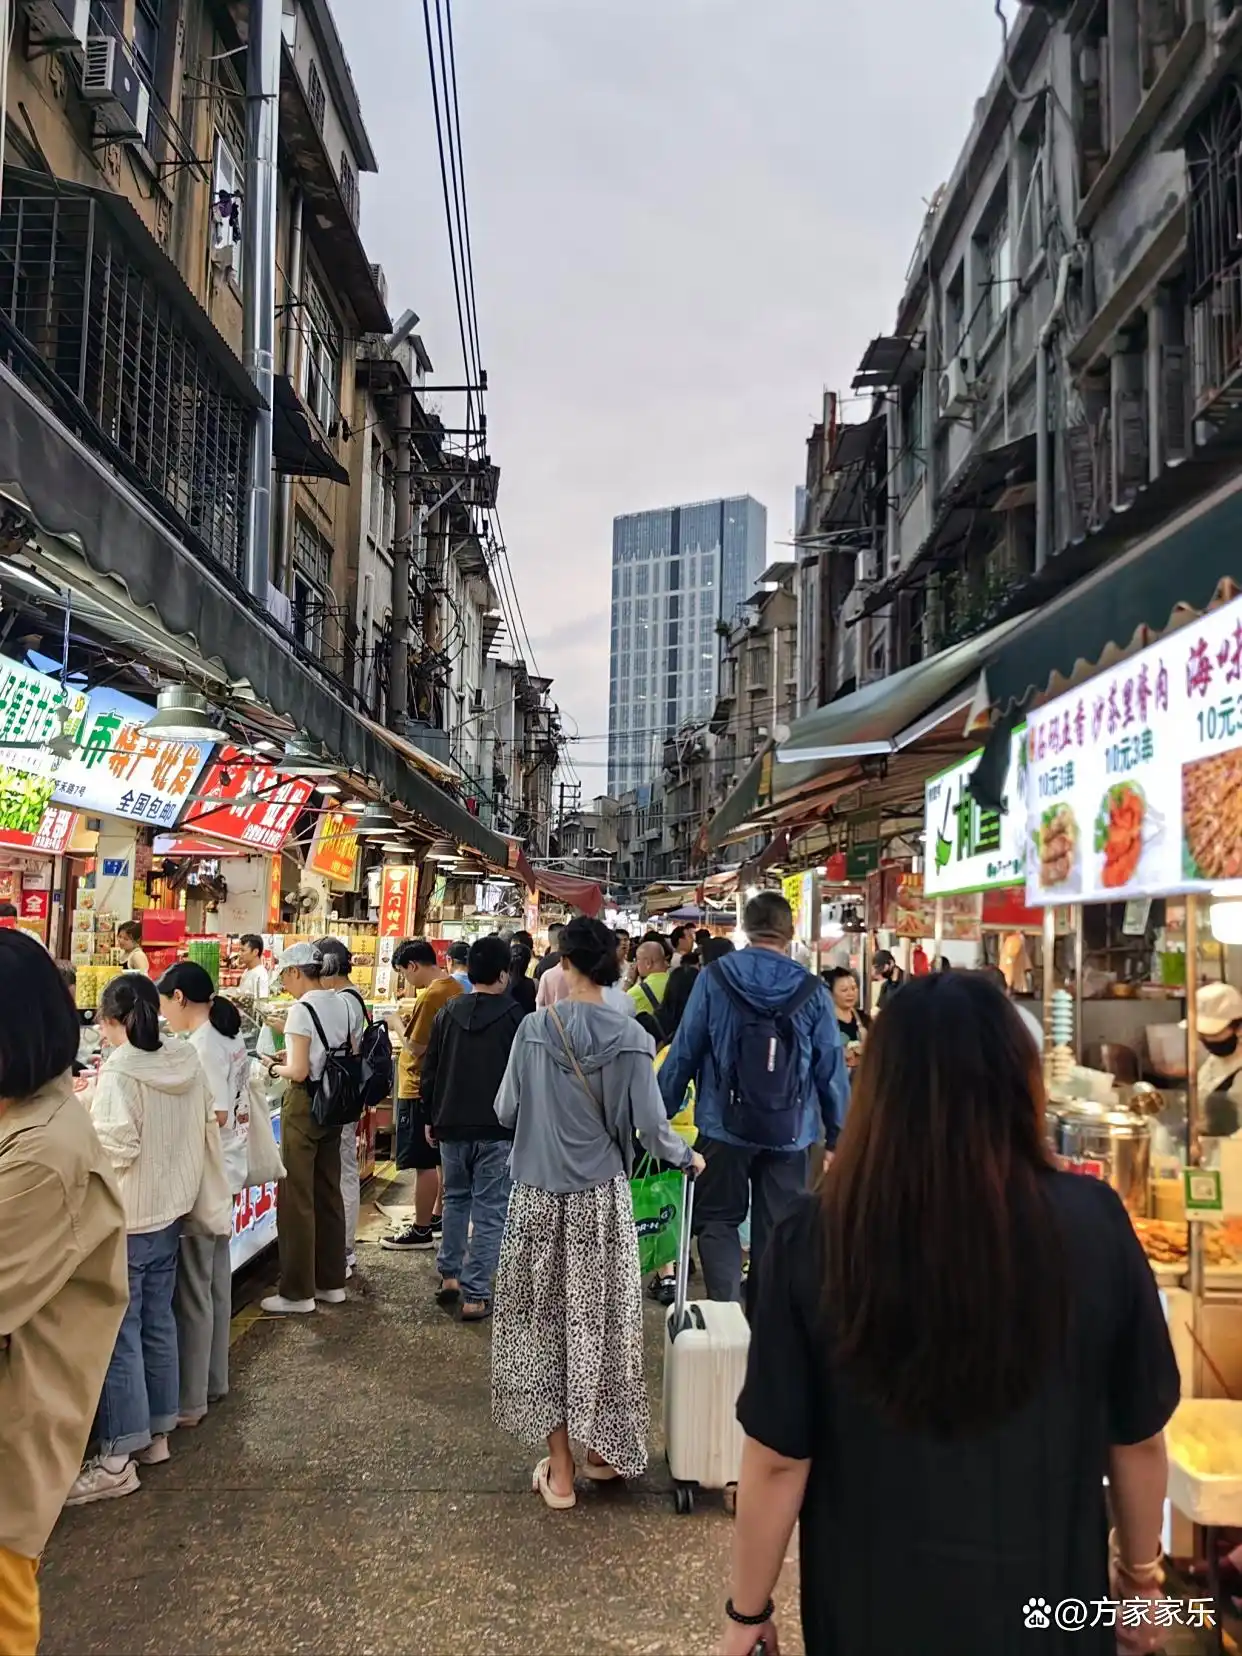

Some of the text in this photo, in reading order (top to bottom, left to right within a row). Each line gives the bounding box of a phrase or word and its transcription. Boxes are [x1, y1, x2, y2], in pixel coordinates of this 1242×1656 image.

[116, 789, 177, 822] 全国包邮
[385, 881, 404, 936] 厦门特产
